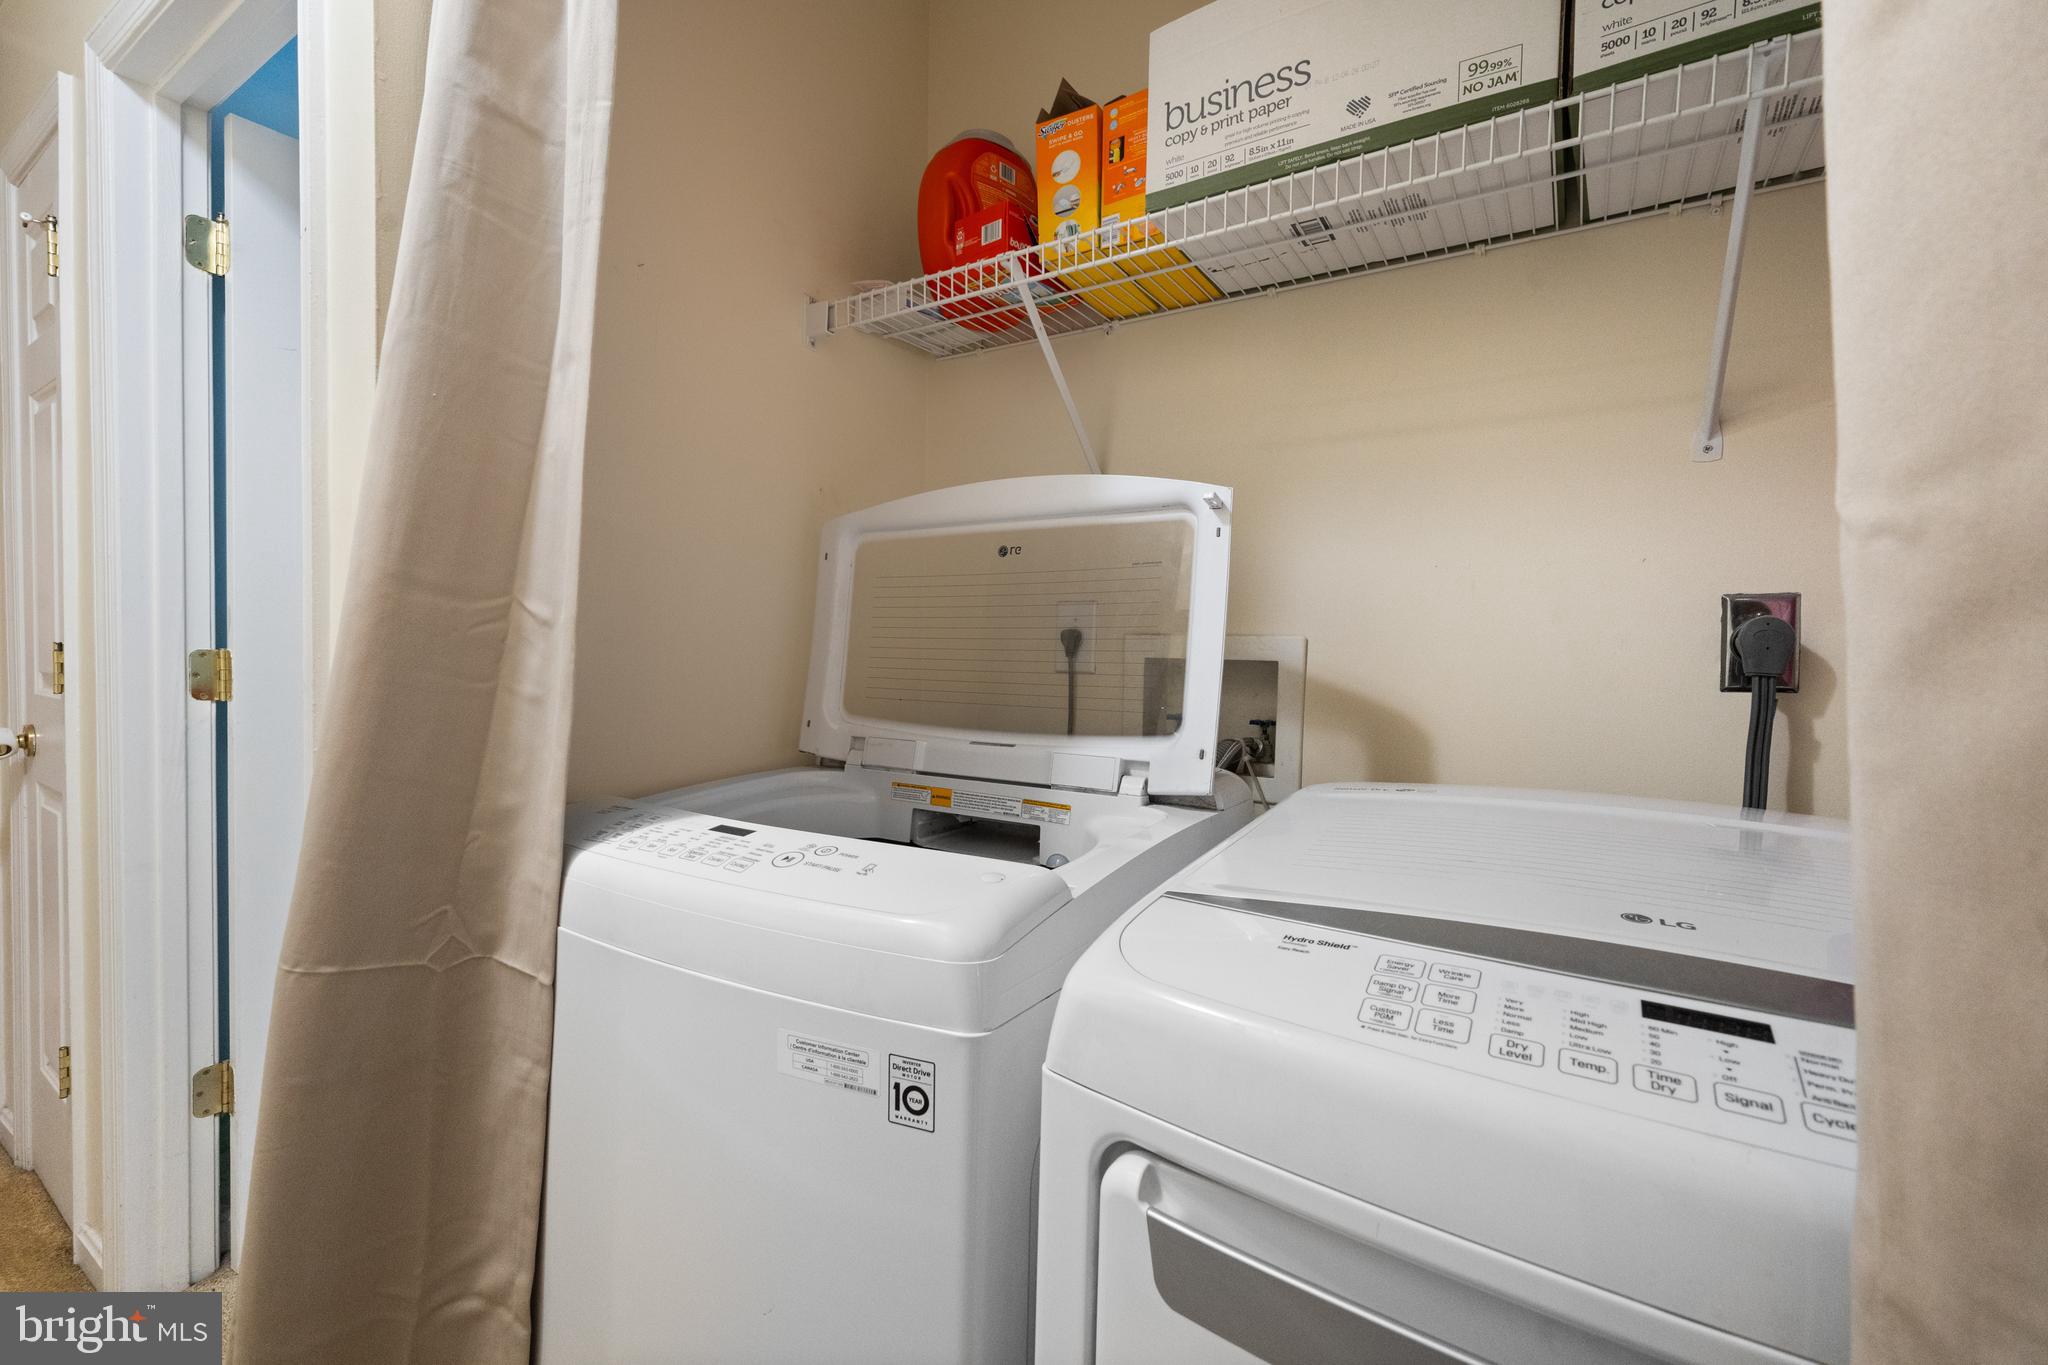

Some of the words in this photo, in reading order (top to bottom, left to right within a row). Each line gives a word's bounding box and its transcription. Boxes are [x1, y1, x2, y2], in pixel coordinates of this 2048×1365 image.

[1700, 7, 1717, 20] 92
[1602, 16, 1633, 32] white
[1671, 16, 1687, 30] 20
[1642, 26, 1657, 39] 10
[1600, 35, 1631, 53] 5000
[1467, 57, 1513, 78] 99.99%
[1424, 77, 1448, 89] Sourcing
[1462, 81, 1484, 96] NO
[1164, 59, 1312, 132] business
[1067, 113, 1095, 127] DUSTERS
[1164, 127, 1198, 148] copy
[1200, 125, 1208, 136] &
[1210, 110, 1245, 135] print
[1248, 95, 1293, 123] paper
[1340, 123, 1357, 132] MADE
[1364, 117, 1377, 126] USA
[1165, 154, 1185, 166] white
[1207, 159, 1218, 169] 20
[1224, 153, 1235, 164] 92
[1190, 164, 1199, 174] 10
[1165, 169, 1184, 182] 5000
[1659, 918, 1697, 931] LG
[1283, 934, 1315, 944] Hydro
[1386, 959, 1415, 968] Energy
[1438, 968, 1472, 979] Wrinkle
[1443, 974, 1464, 982] Care
[1373, 979, 1397, 988] Damp
[1398, 983, 1414, 992] Dry
[1379, 986, 1405, 996] Signal
[1438, 991, 1461, 1000] More
[1504, 997, 1524, 1005] Very
[1438, 998, 1459, 1006] Time
[1503, 1004, 1525, 1012] More
[1369, 1004, 1402, 1017] Custom
[1374, 1011, 1394, 1021] PGM
[1502, 1011, 1533, 1021] Normal
[1570, 1010, 1590, 1018] High
[1432, 1017, 1455, 1028] Less
[1501, 1018, 1521, 1027] Less
[1569, 1017, 1586, 1025] Mid
[1586, 1020, 1608, 1029] High
[1432, 1024, 1455, 1034] Time
[1500, 1027, 1524, 1036] Damp
[1569, 1024, 1605, 1036] Medium
[1569, 1033, 1589, 1041] Low
[795, 1038, 817, 1048] Customer
[817, 1043, 844, 1054] Information
[844, 1049, 860, 1058] Center
[1506, 1039, 1529, 1052] Dry
[1568, 1041, 1591, 1050] Ultra
[1592, 1046, 1612, 1055] Low
[1715, 1039, 1739, 1049] High
[1499, 1047, 1533, 1062] Level
[1718, 1056, 1741, 1065] Low
[801, 1064, 819, 1072] CANADA
[1650, 1058, 1662, 1066] 20
[892, 1062, 912, 1074] Direct
[912, 1067, 931, 1077] Drive
[1646, 1068, 1683, 1086] Time
[1721, 1073, 1739, 1083] Off
[1650, 1080, 1677, 1096] Dry
[892, 1081, 930, 1117] 10
[908, 1097, 923, 1105] YEAR
[1724, 1091, 1774, 1112] Signal
[894, 1113, 929, 1126] WARRANTY
